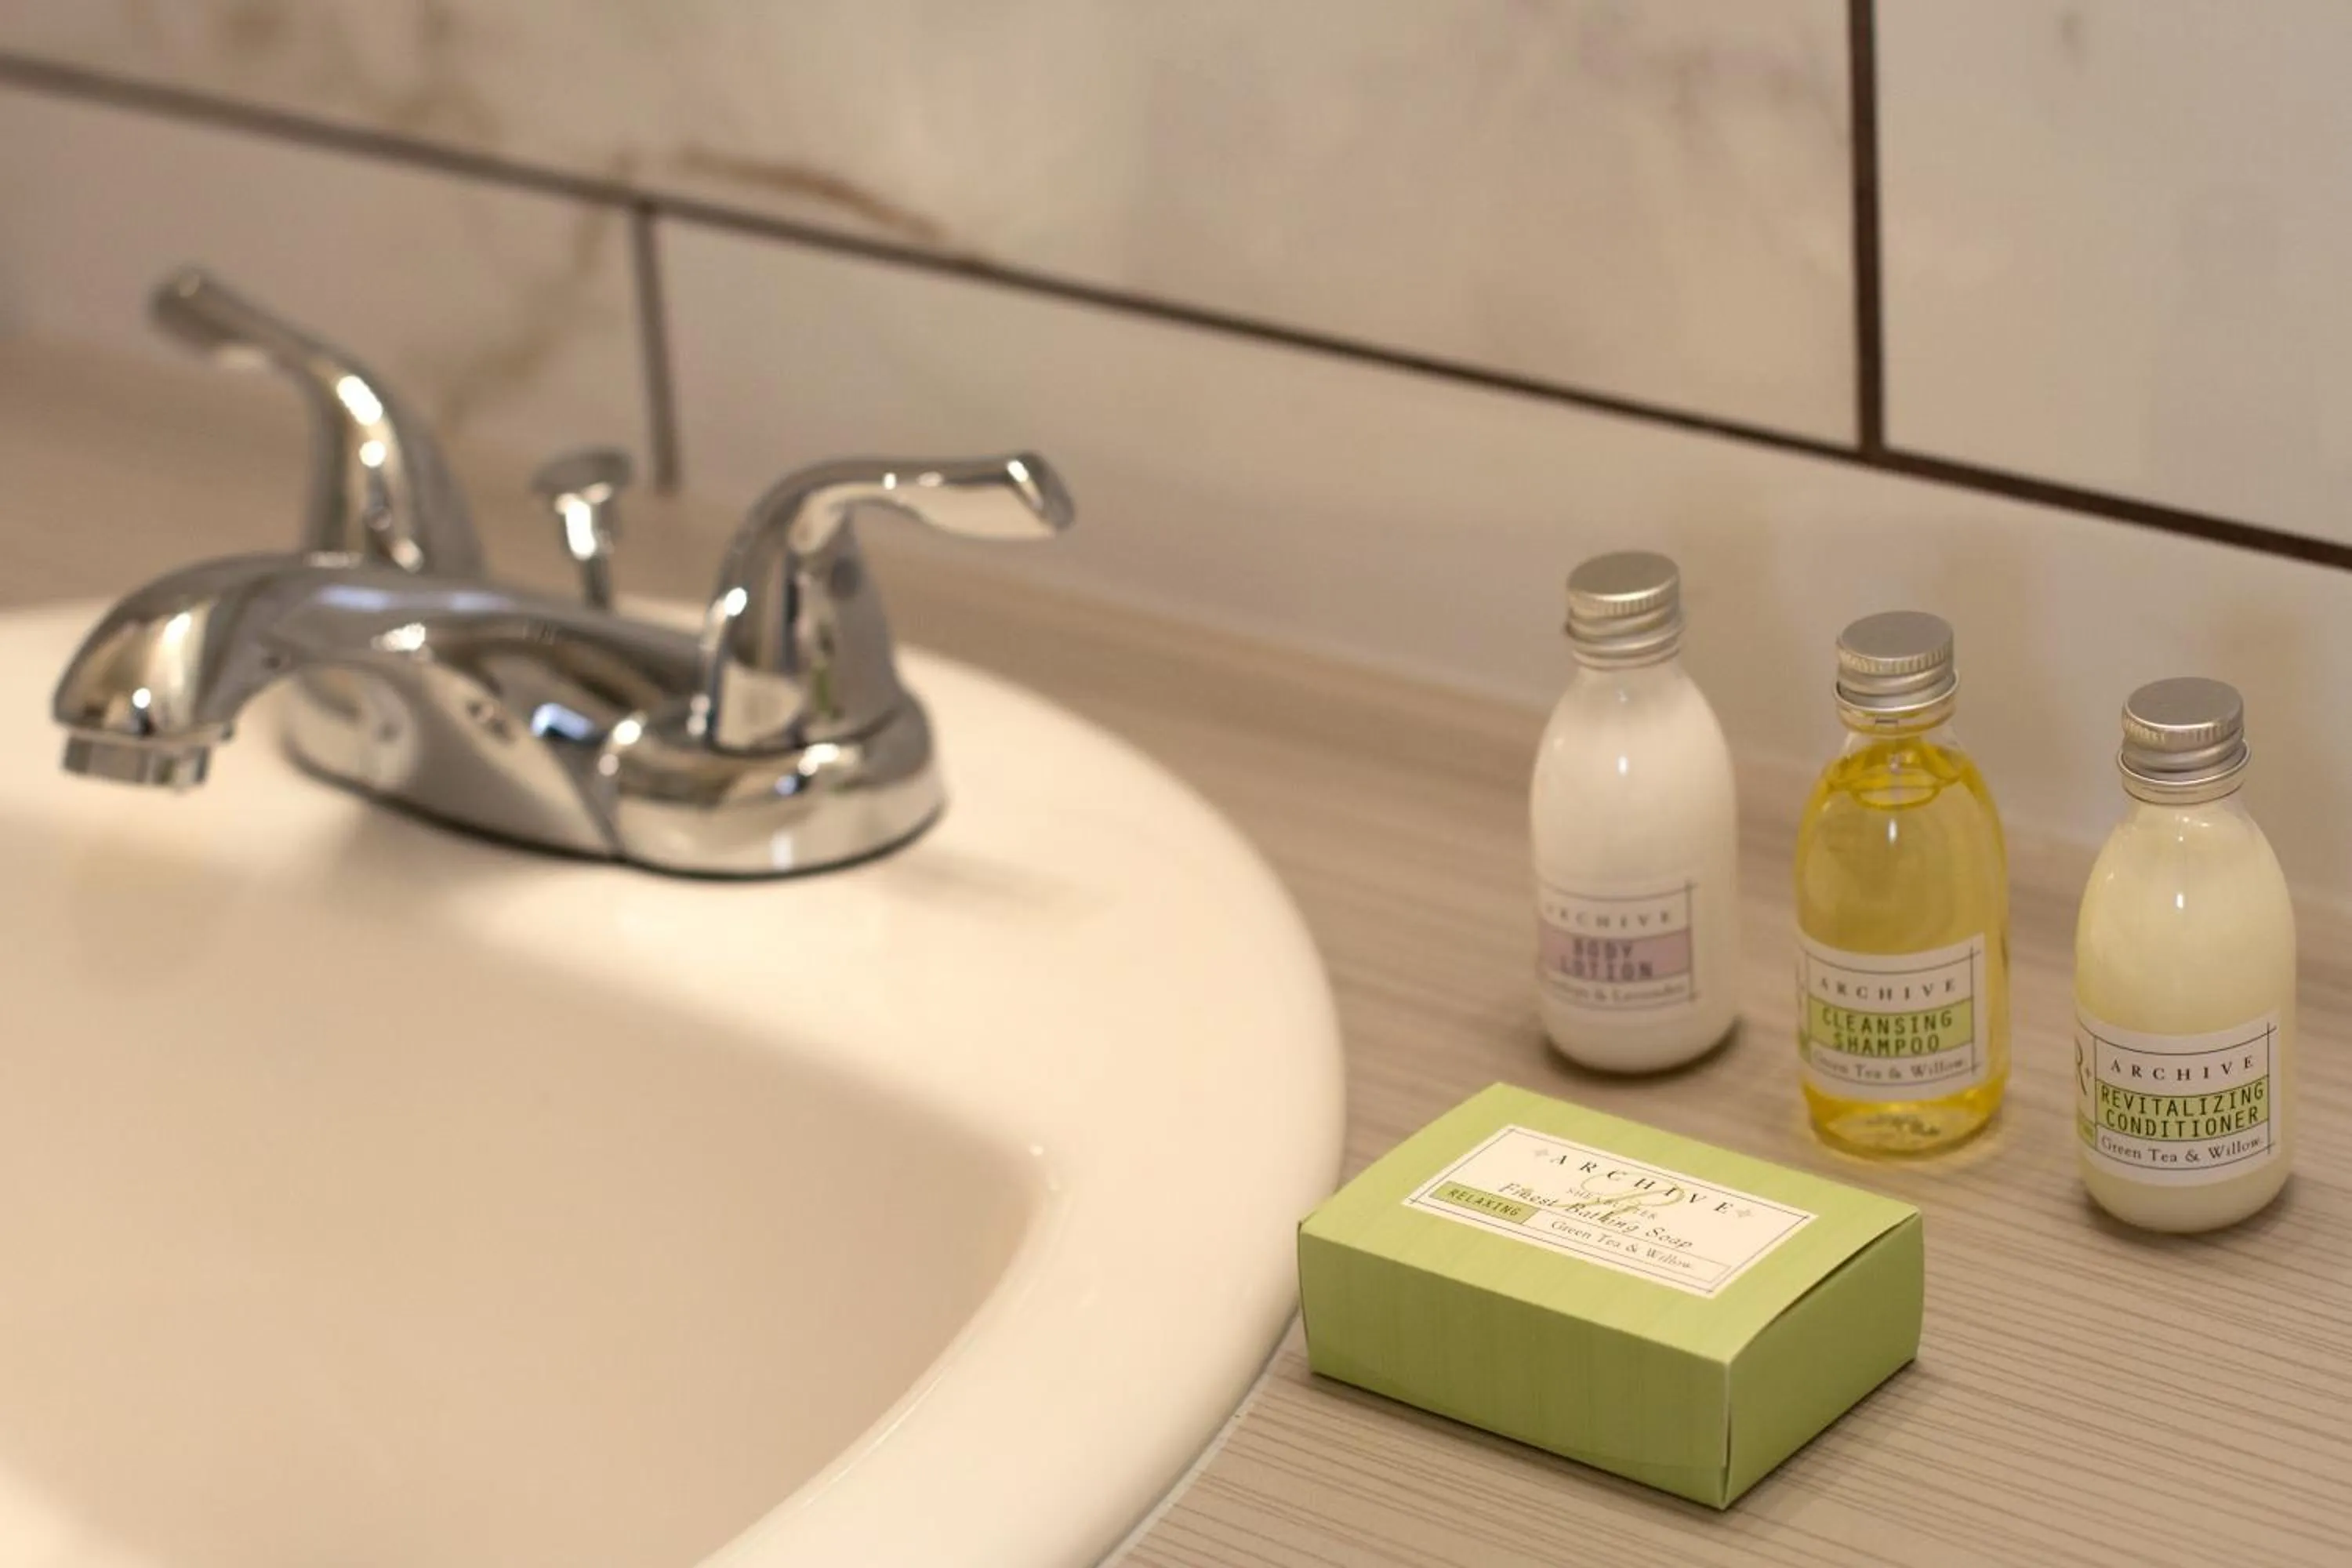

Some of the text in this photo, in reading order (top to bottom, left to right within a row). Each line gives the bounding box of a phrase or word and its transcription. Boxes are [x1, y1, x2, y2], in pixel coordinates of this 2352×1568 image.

[1819, 978, 1956, 1001] ARCHIVE
[1820, 1007, 1954, 1035] CLEANSING
[1832, 1032, 1940, 1057] SHAMPOO
[1854, 1063, 1882, 1080] Tea
[1888, 1066, 1903, 1079] &
[2110, 1054, 2255, 1081] ARCHIVE
[2100, 1081, 2264, 1117] REVITALIZING
[2106, 1105, 2259, 1138] CONDITIONER
[2101, 1135, 2261, 1163] Green Tea & Willow
[1549, 1154, 1734, 1214] ARCHIVE
[1448, 1188, 1522, 1217] RELAXING
[1497, 1182, 1693, 1248] Finest Bathing Soap
[1551, 1219, 1592, 1240] Green
[1598, 1233, 1622, 1248] Tea
[1625, 1243, 1638, 1253] &
